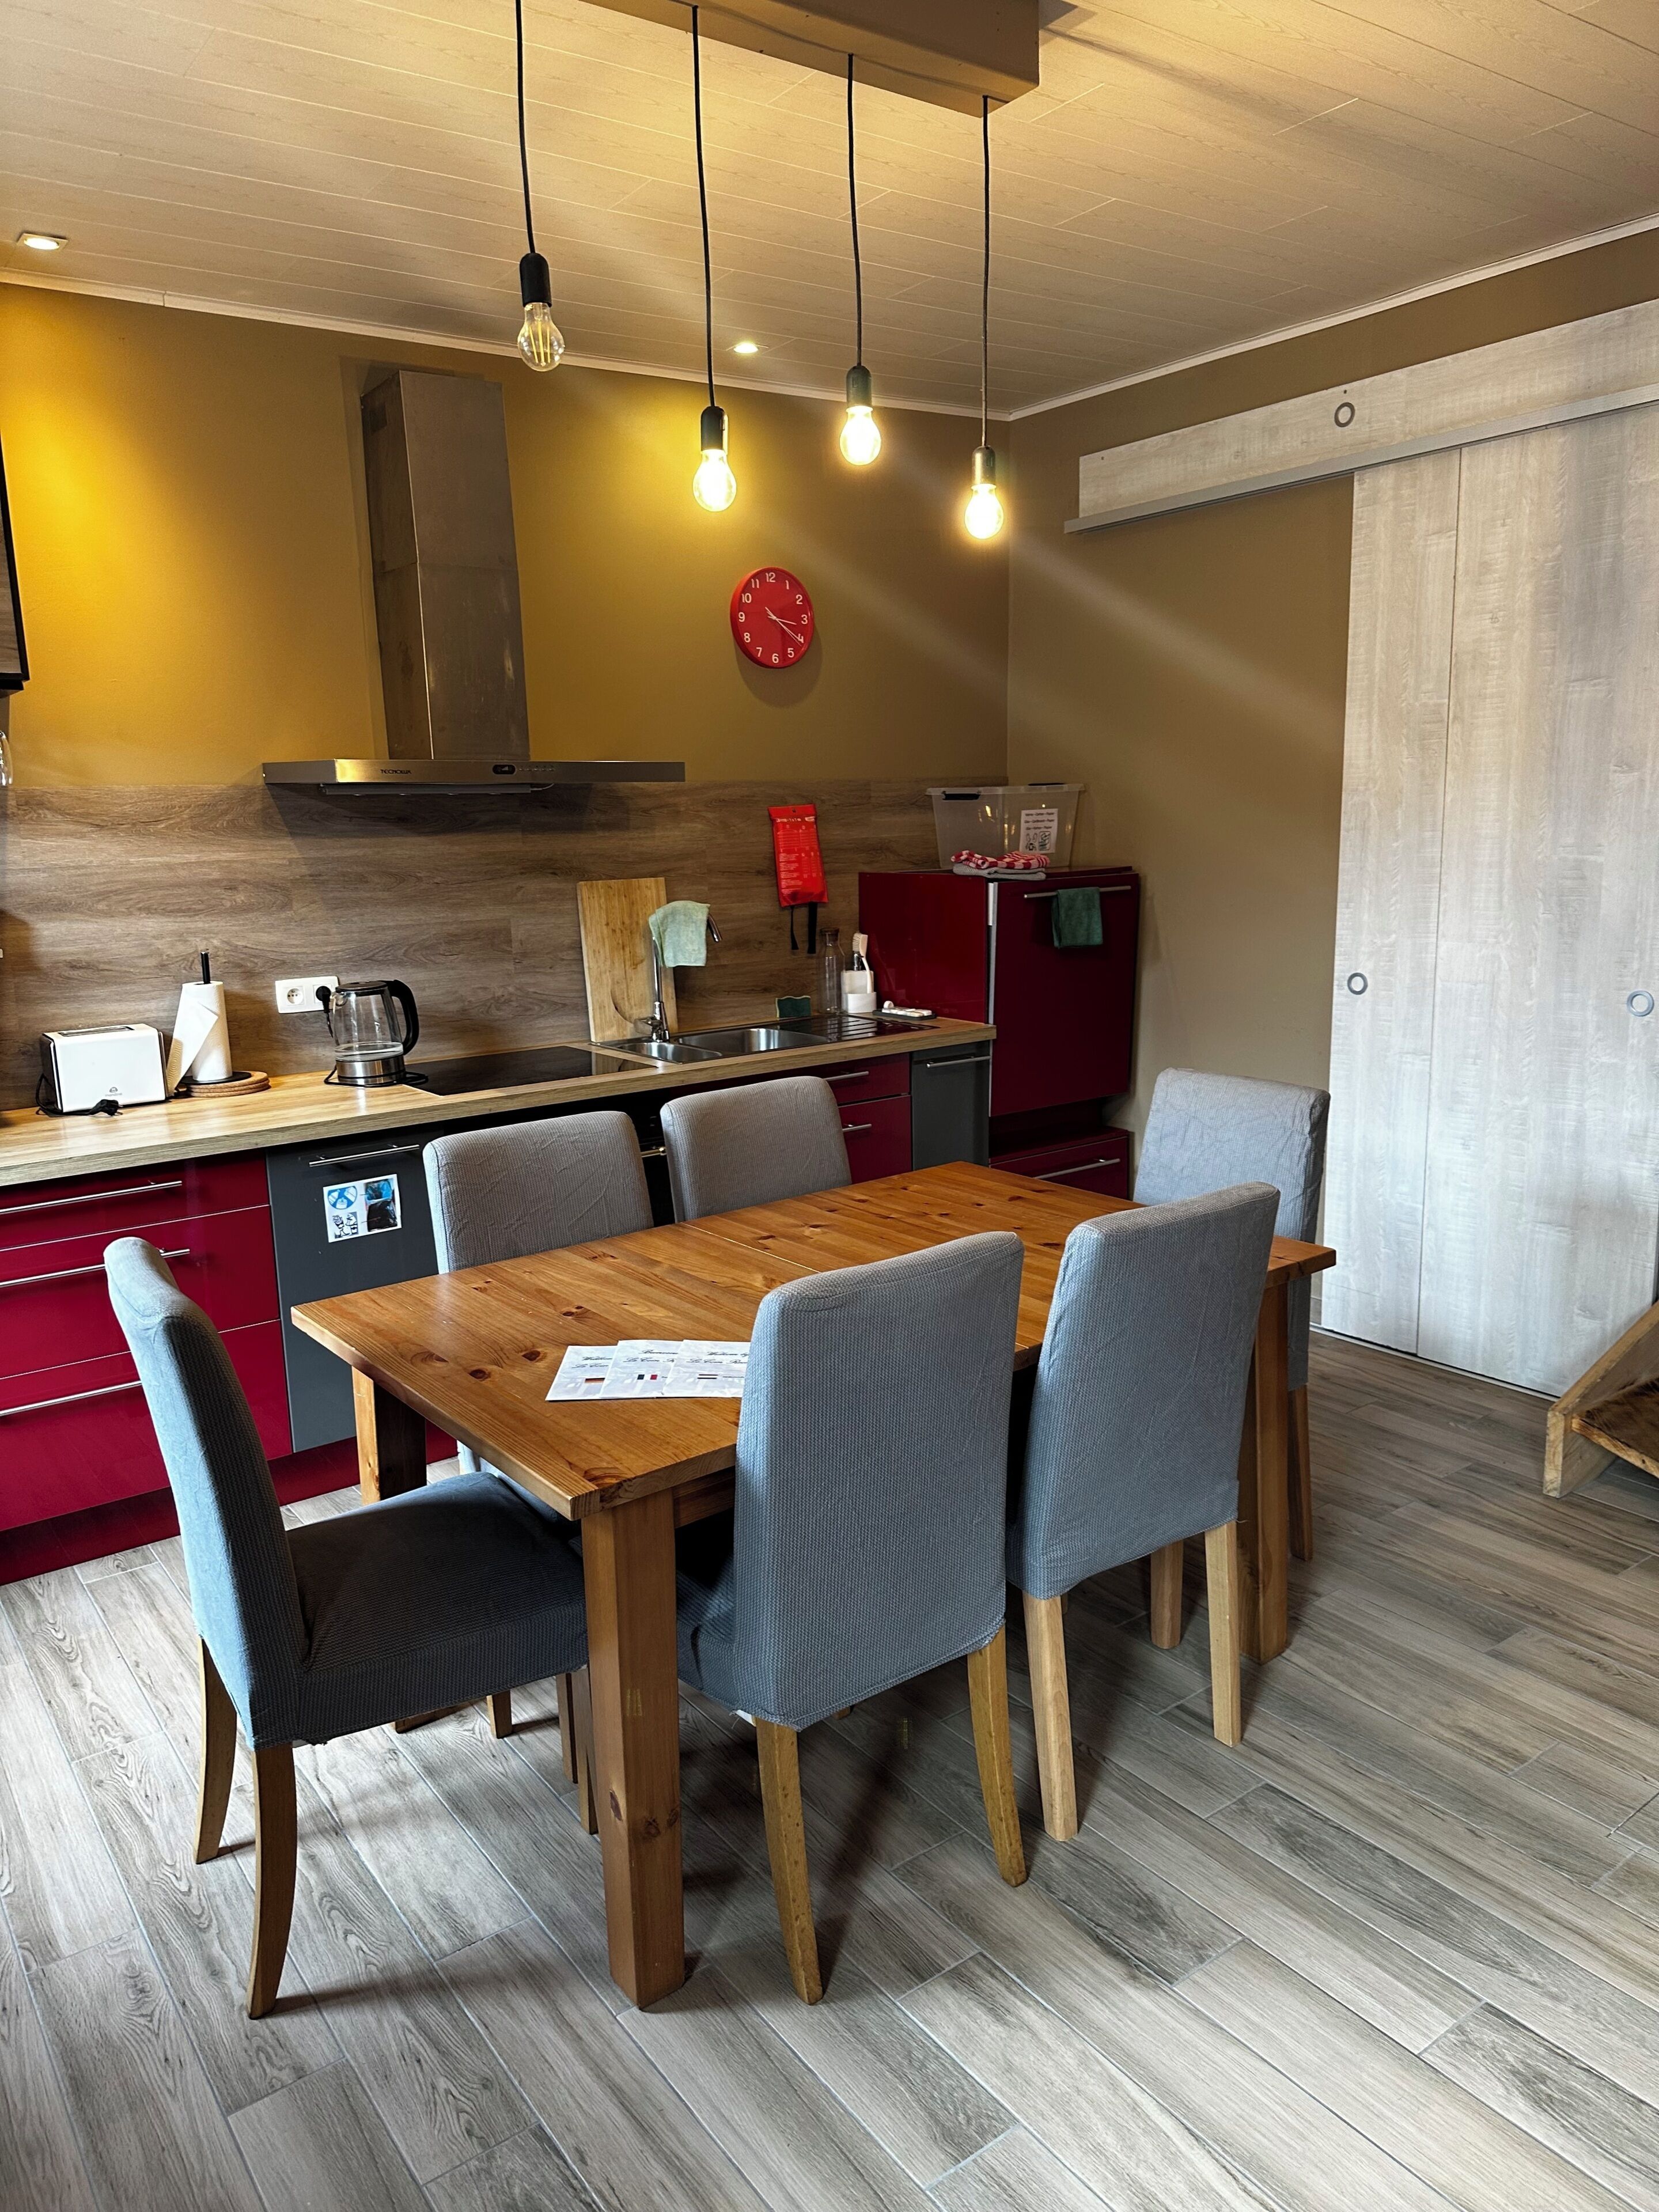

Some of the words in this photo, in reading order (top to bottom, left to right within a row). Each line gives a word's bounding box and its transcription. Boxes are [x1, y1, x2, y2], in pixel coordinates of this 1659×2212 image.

[766, 572, 775, 582] 12
[751, 579, 759, 588] 11
[786, 580, 790, 590] 1
[742, 593, 752, 603] 10
[796, 594, 803, 604] 2
[738, 612, 745, 622] 9
[801, 615, 808, 624] 3
[744, 632, 751, 642] 8
[797, 634, 804, 643] 4
[756, 647, 762, 657] 7
[787, 648, 794, 658] 5
[772, 653, 779, 664] 6
